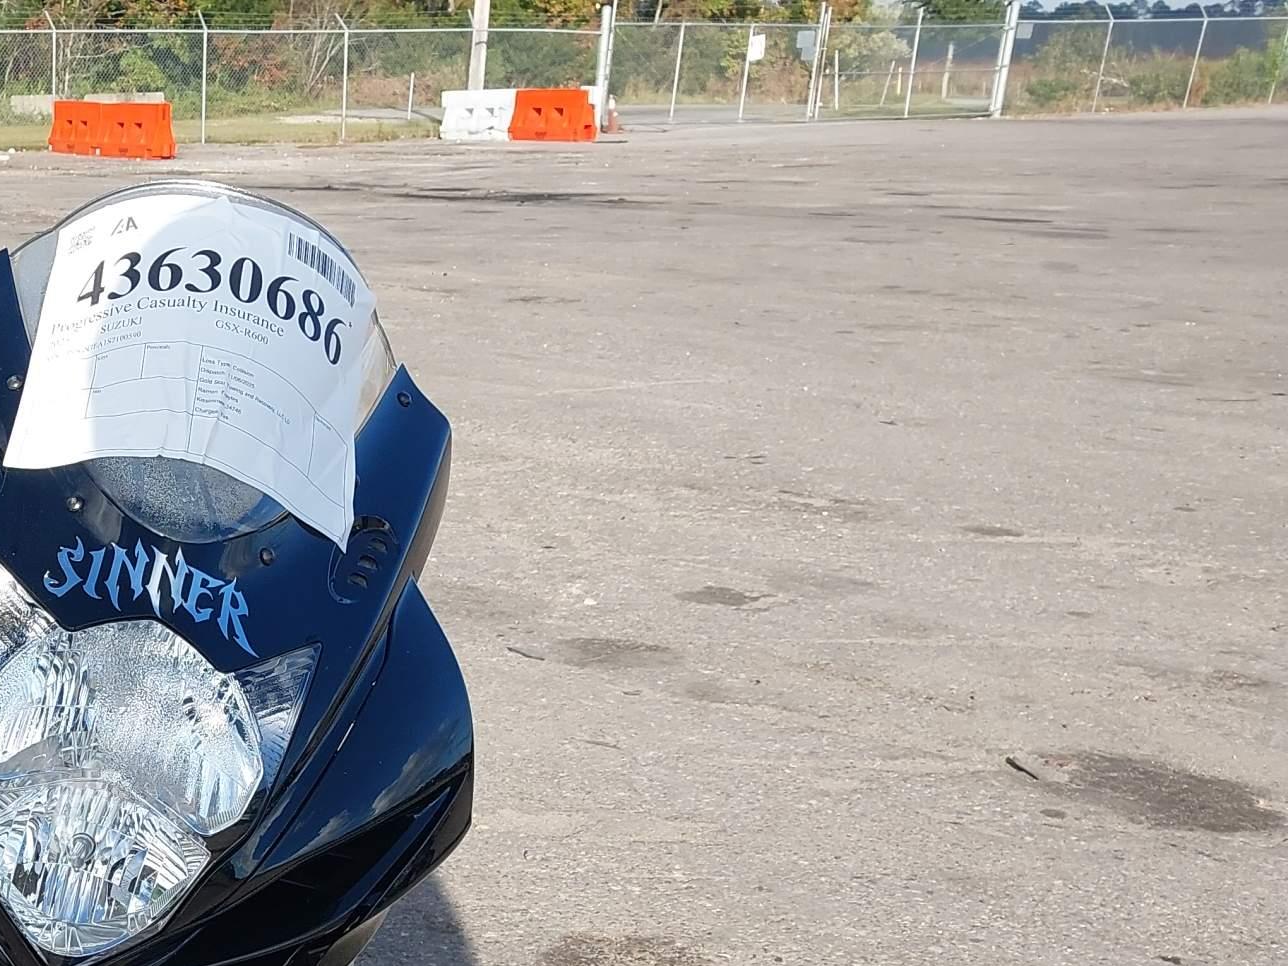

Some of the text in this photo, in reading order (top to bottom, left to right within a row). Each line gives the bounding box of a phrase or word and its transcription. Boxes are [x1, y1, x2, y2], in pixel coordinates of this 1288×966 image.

[77, 246, 347, 365] 43630686
[100, 316, 143, 335] SUZUKI
[137, 295, 208, 313] Casualty
[213, 300, 284, 337] Insurance
[215, 319, 269, 345] GSX-R600
[43, 536, 260, 659] SINNER
